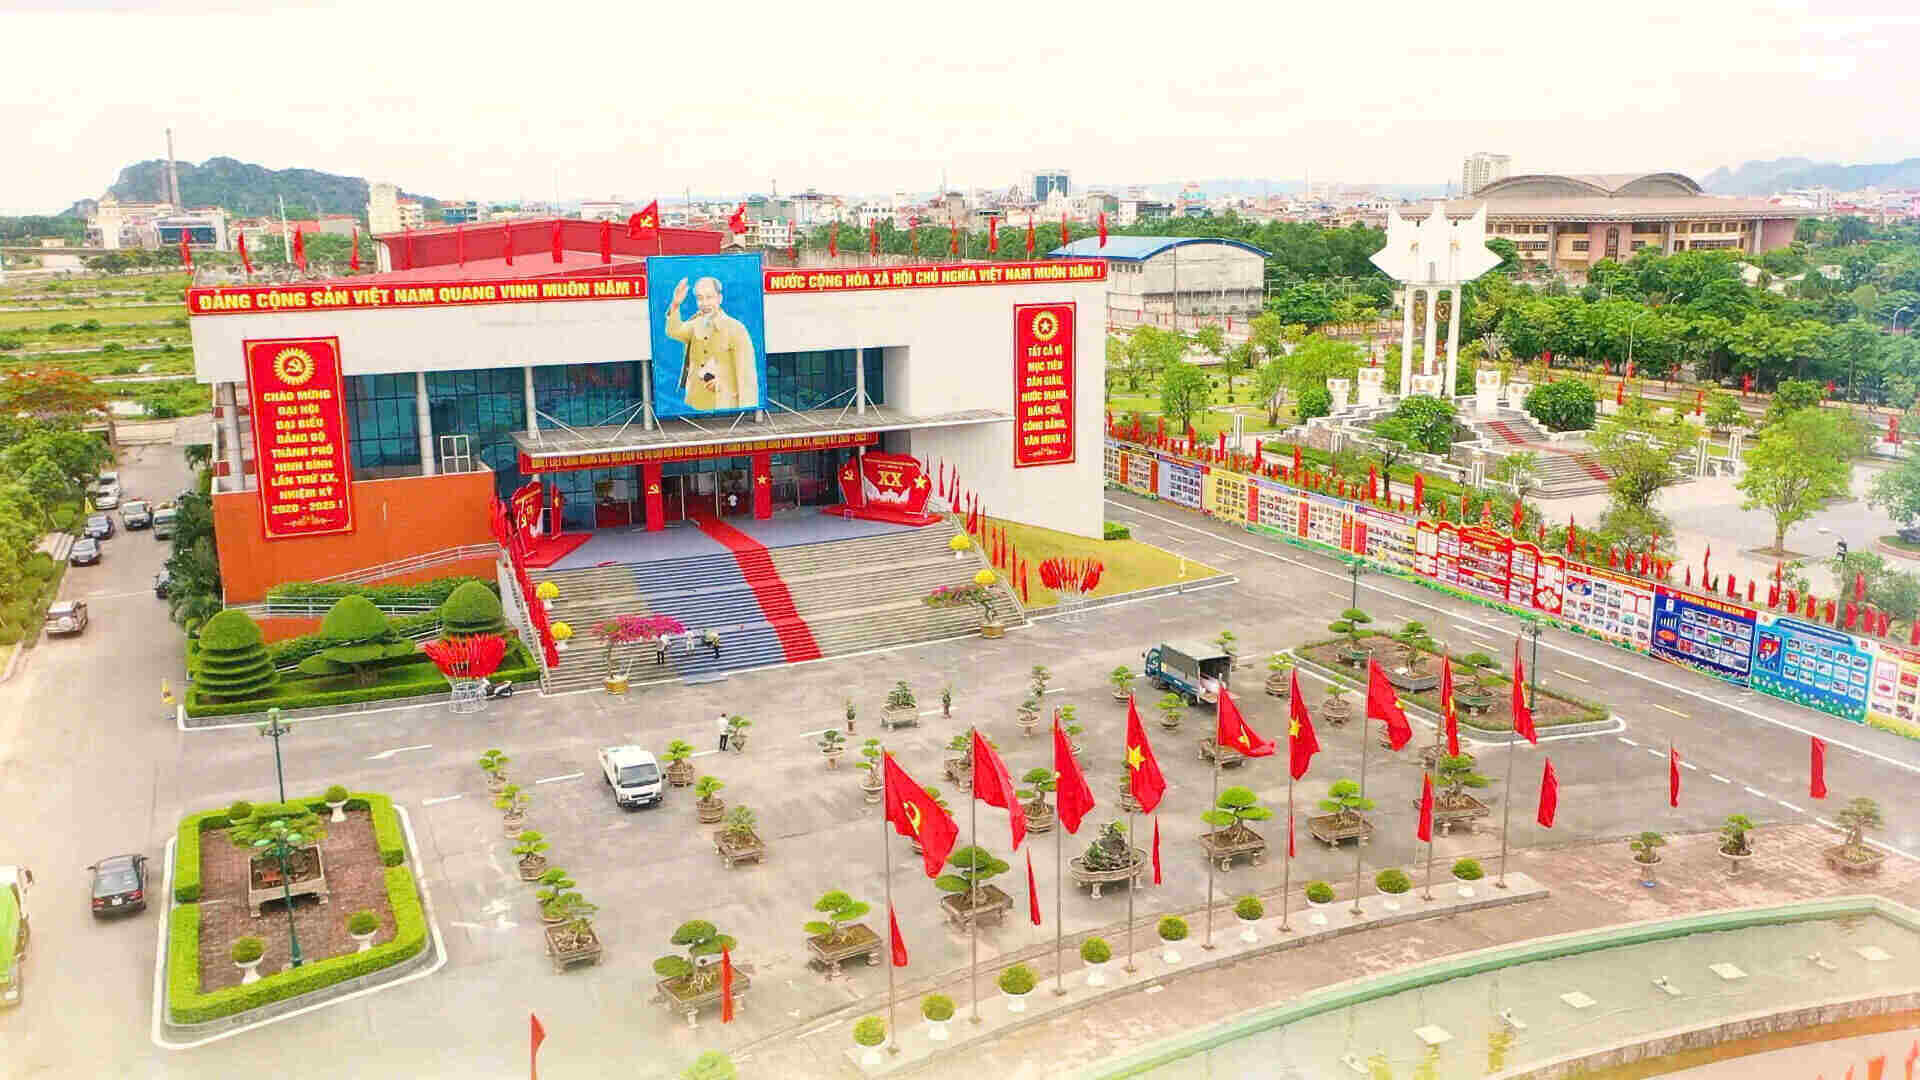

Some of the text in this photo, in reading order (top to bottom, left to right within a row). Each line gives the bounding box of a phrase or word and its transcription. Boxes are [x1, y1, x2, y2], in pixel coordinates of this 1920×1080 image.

[771, 272, 806, 289] NƯỚC
[808, 273, 842, 291] CỘNG
[893, 269, 912, 287] HỘI
[916, 266, 939, 283] CHỦ
[942, 267, 977, 283] NGHĨA
[979, 266, 1002, 283] VIỆT
[1005, 267, 1031, 281] NAM
[1033, 264, 1066, 280] MUÔN
[1070, 264, 1095, 278] NĂM
[200, 290, 251, 310] ĐẢNG
[256, 290, 306, 310] CỘNG
[312, 287, 348, 306] SẢN
[353, 287, 389, 306] VIỆT
[394, 288, 434, 303] NAM
[439, 286, 496, 303] QUANG
[499, 283, 538, 298] VINH
[542, 280, 589, 297] MUÔN
[594, 279, 630, 295] NĂM
[264, 388, 331, 402] CHÀO MỪNG
[277, 404, 320, 416] ĐẠI HỘI
[275, 416, 324, 430] ĐẠI BIỂU
[276, 430, 326, 444] ĐẢNG BỘ
[271, 443, 334, 459] THÀNH PHỐ
[274, 461, 303, 472] NINH
[271, 474, 294, 486] LẦN
[296, 473, 319, 484] THỨ
[877, 470, 904, 487] XX
[279, 486, 333, 500] NHIỆM KỲ
[271, 504, 299, 514] 2020
